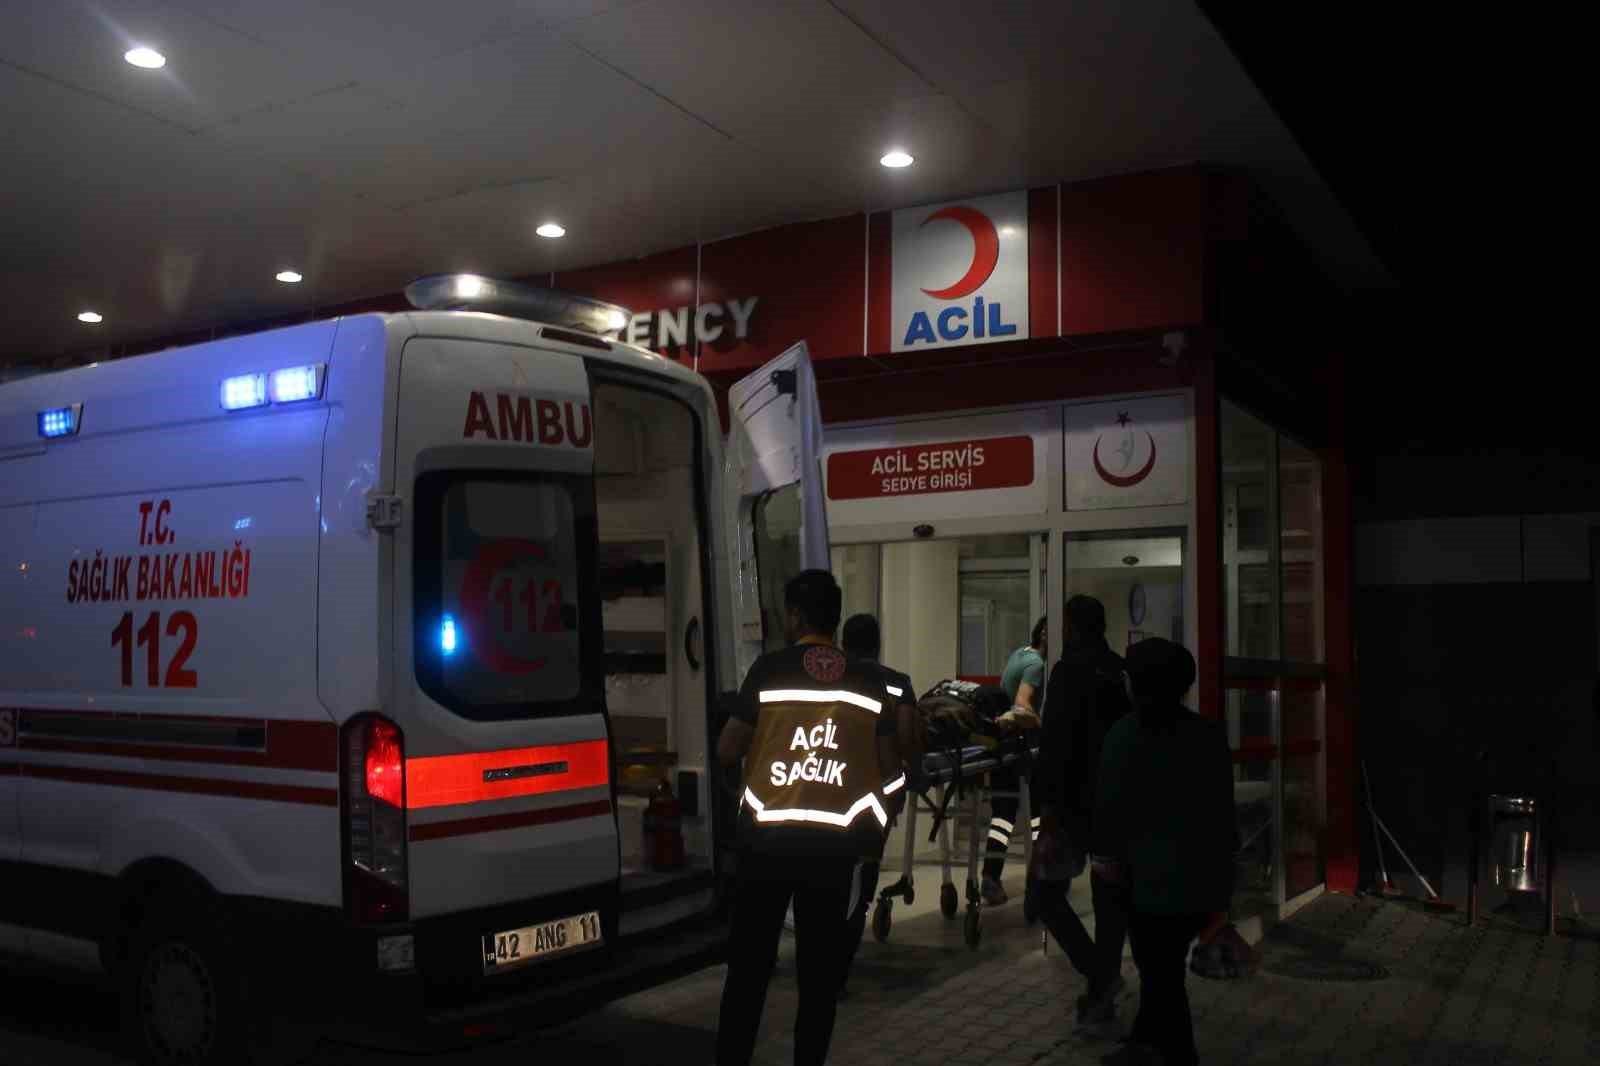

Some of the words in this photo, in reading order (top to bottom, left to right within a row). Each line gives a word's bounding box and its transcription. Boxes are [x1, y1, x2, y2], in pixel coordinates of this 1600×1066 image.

[618, 297, 758, 349] ENCY
[903, 297, 1017, 346] ACİL
[463, 390, 592, 448] AMBU
[871, 449, 913, 475] ACİL
[917, 443, 985, 471] SERVİS
[881, 475, 927, 493] SEDYE
[929, 470, 972, 491] GİRİŞİ
[138, 499, 175, 546] T.C.
[67, 549, 132, 603] SAĞLIK
[136, 541, 250, 599] BAKANLIĞI
[493, 577, 563, 633] 112
[111, 610, 198, 688] 112
[789, 717, 840, 751] ACİL
[769, 750, 847, 787] SAĞLIK
[498, 932, 521, 960] 42
[535, 922, 567, 953] ANG
[579, 913, 598, 942] 11
